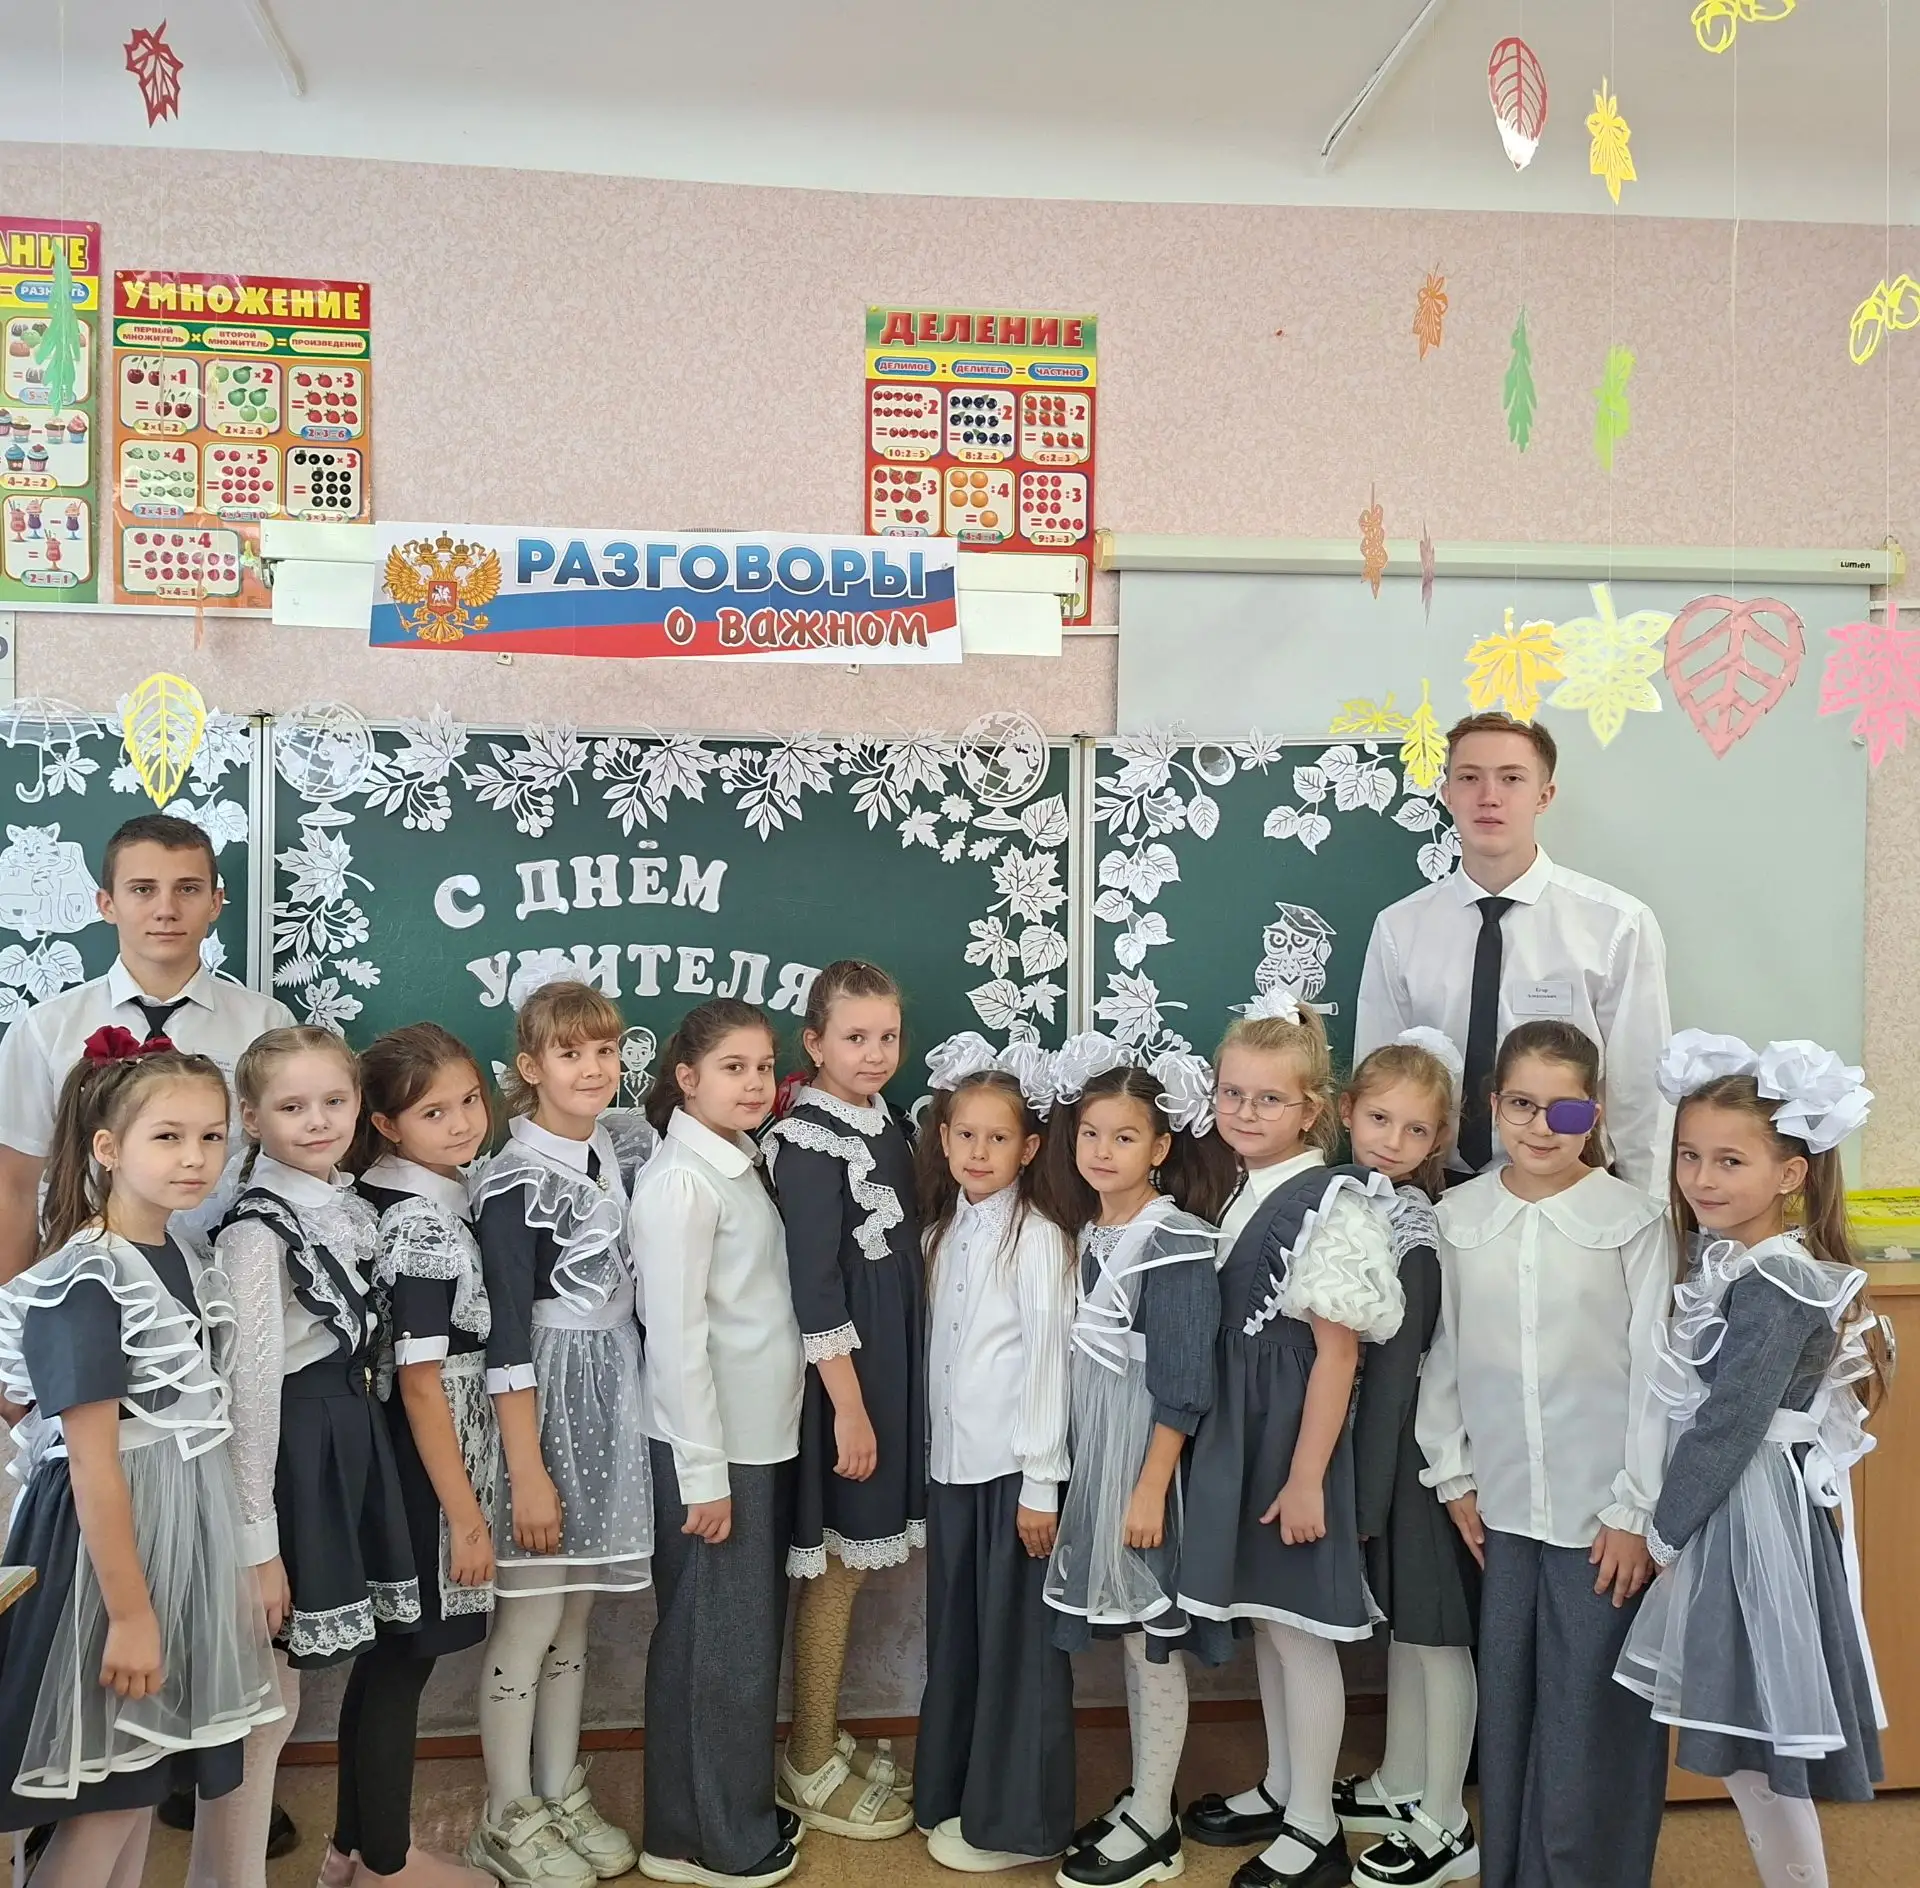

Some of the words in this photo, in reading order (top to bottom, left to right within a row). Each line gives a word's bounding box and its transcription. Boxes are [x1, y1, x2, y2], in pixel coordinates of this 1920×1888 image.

[20, 285, 86, 297] РАЗНТЬ
[122, 280, 361, 320] УМНОЖЕНИЕ
[133, 325, 174, 336] ПЕРВЫЙ
[218, 330, 257, 340] ВТОРОЙ
[879, 311, 1085, 348] ДЕЛЕНИЕ
[122, 333, 185, 344] МНОЖИТЕЛЬ
[207, 337, 269, 348] МНОЖИТЕЛЬ
[291, 337, 364, 349] ПРОИЗВЕДЕНИЕ
[879, 360, 932, 372] ДЕЛИМОЕ
[955, 365, 1010, 376] ДЕЛИТЕЛЬ
[1035, 368, 1084, 378] ЧАСТНОЕ
[514, 536, 928, 599] РАЗГОВОРЫ
[514, 839, 728, 921] ДНЁМ
[465, 944, 824, 1017] УИТЕЛЯ
